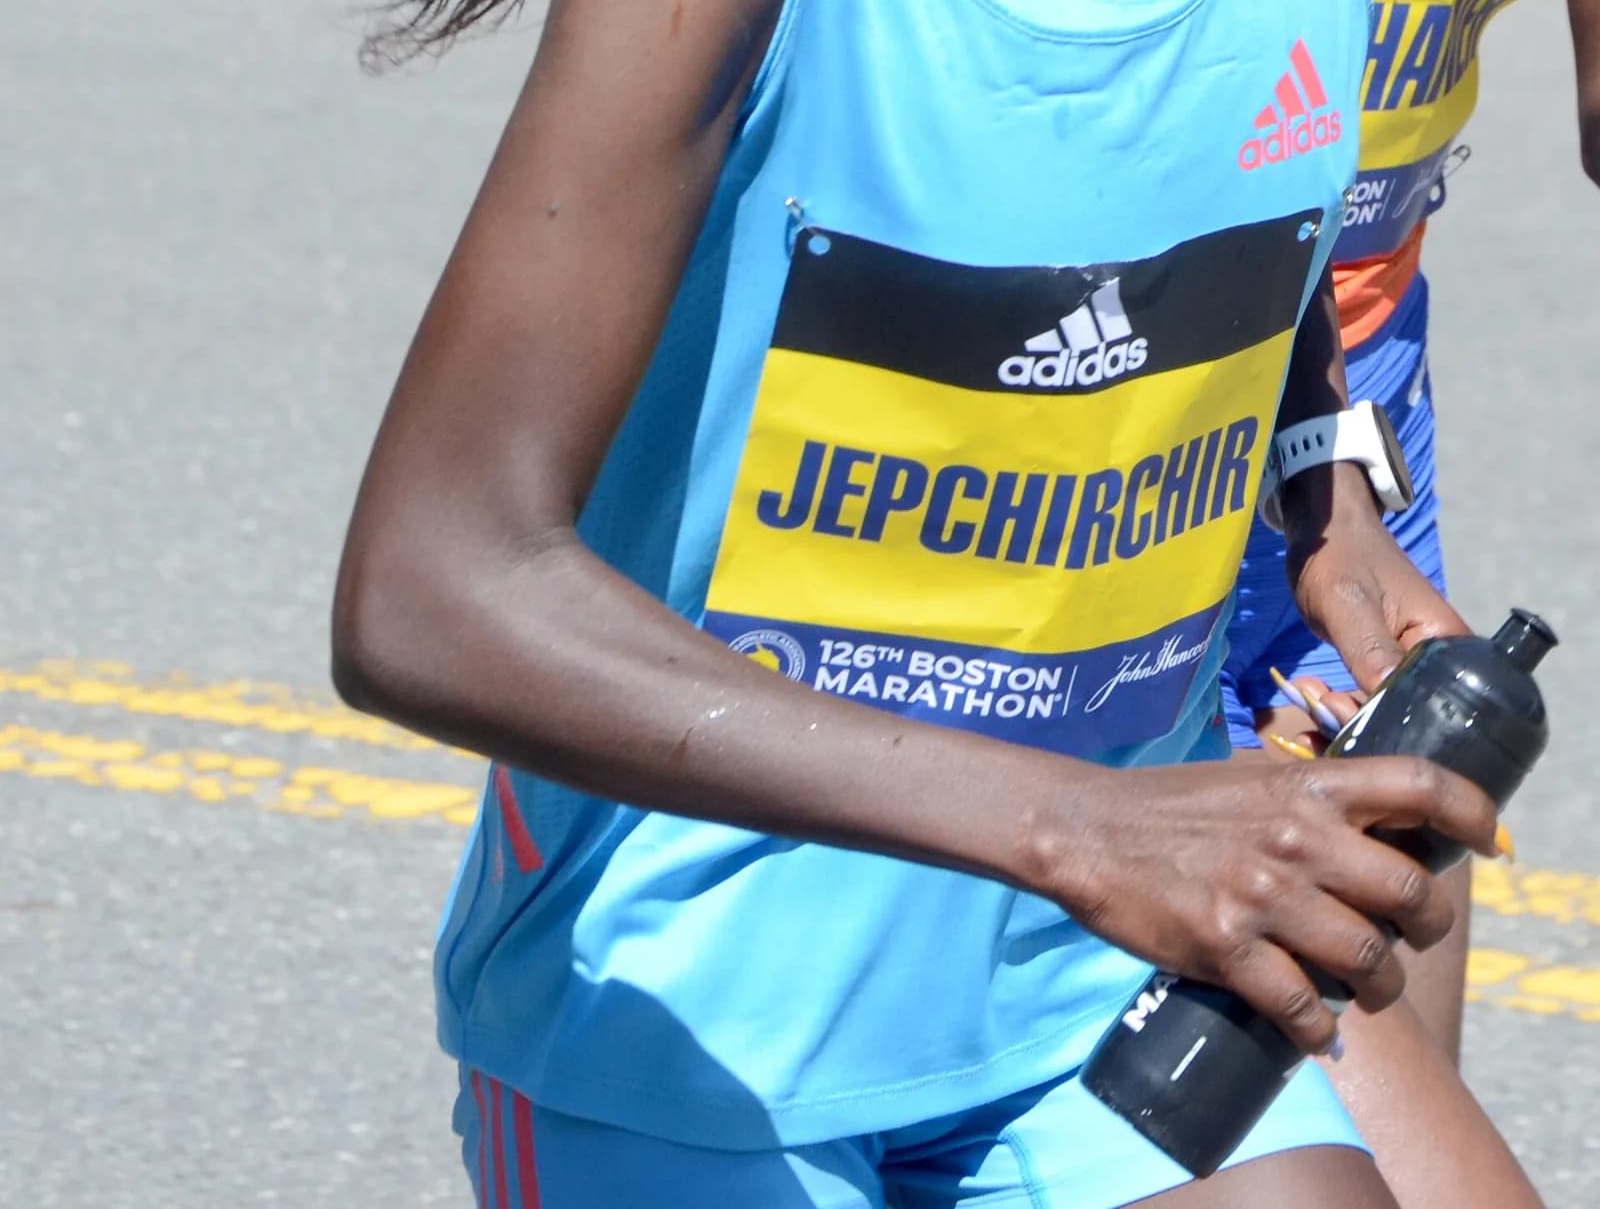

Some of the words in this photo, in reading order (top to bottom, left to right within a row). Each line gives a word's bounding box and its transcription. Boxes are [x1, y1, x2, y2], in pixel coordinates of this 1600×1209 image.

[1237, 109, 1342, 171] adidas
[998, 338, 1148, 387] adidas
[756, 416, 1259, 569] JEPCHIRCHIR
[813, 666, 1058, 719] MARATHON
[819, 639, 904, 669] 126TH
[907, 650, 1063, 692] BOSTON
[1084, 651, 1151, 713] John
